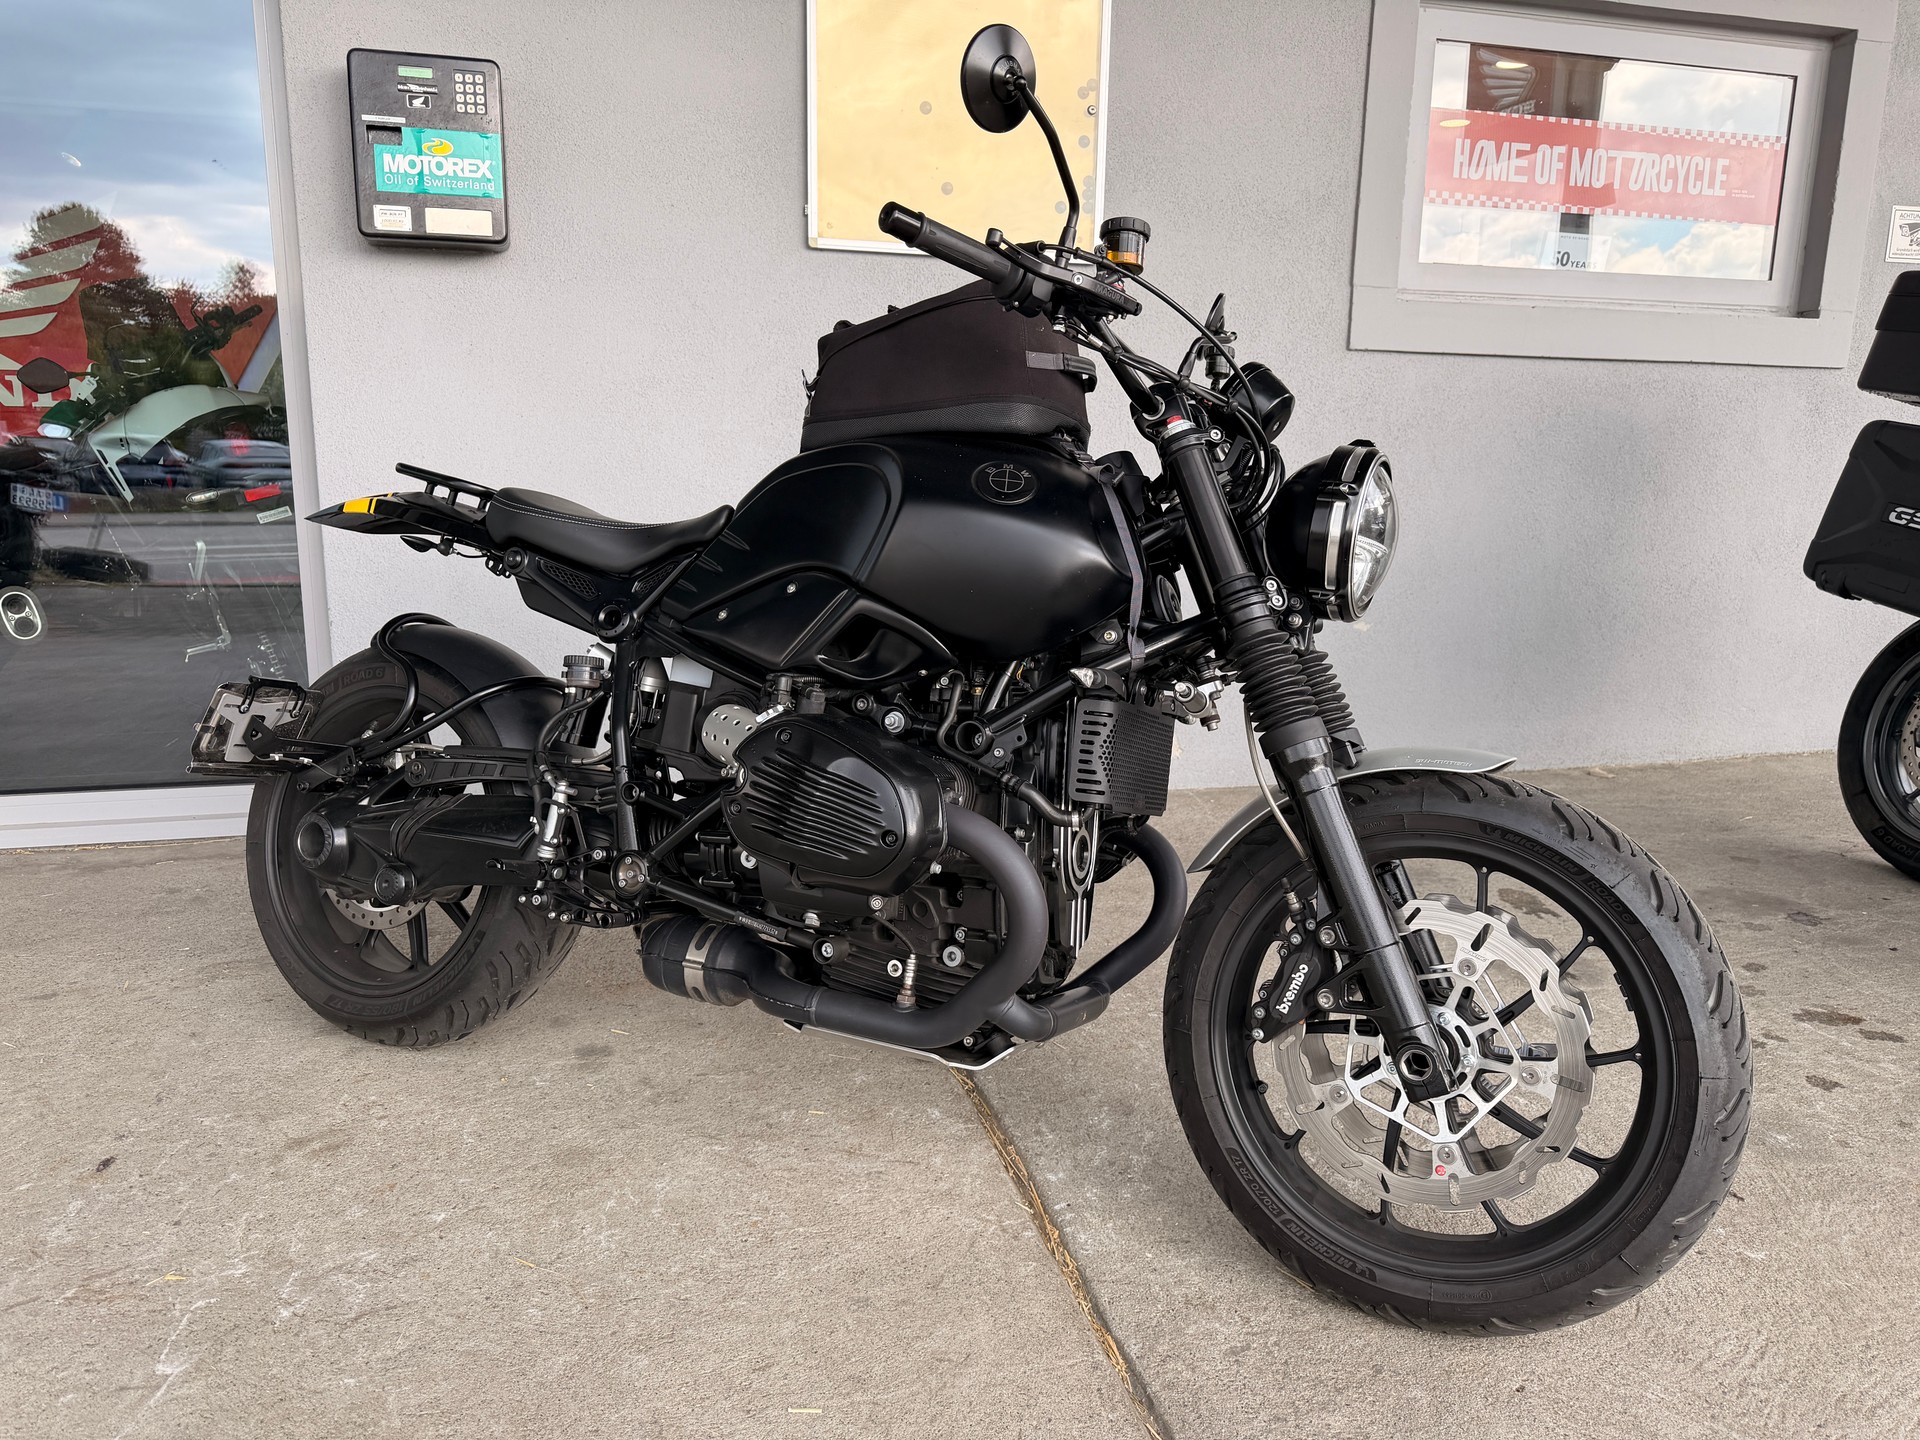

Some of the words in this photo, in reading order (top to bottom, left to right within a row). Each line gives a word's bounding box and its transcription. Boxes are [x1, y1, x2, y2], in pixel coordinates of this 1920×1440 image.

[383, 153, 494, 179] MOTOREX
[1452, 137, 1530, 184] HOME
[1535, 144, 1565, 185] OF
[1569, 147, 1729, 197] MOTORCYCLE
[384, 174, 402, 185] Oil
[406, 175, 419, 186] of
[423, 176, 495, 191] Switzerland
[1900, 212, 1920, 220] ACHTUN
[1095, 284, 1125, 304] MAGURA
[984, 463, 1032, 478] BMW
[344, 669, 373, 686] ROAD
[375, 667, 385, 677] 6
[1504, 832, 1582, 874] MICHELIN
[1587, 878, 1622, 910] ROAD
[412, 955, 470, 1006] MICHELIN
[1276, 964, 1309, 1014] brembo
[1231, 1154, 1242, 1167] 17
[1239, 1166, 1252, 1182] ZR
[1250, 1183, 1281, 1217] 120/70
[1286, 1222, 1352, 1268] MICHELIN
